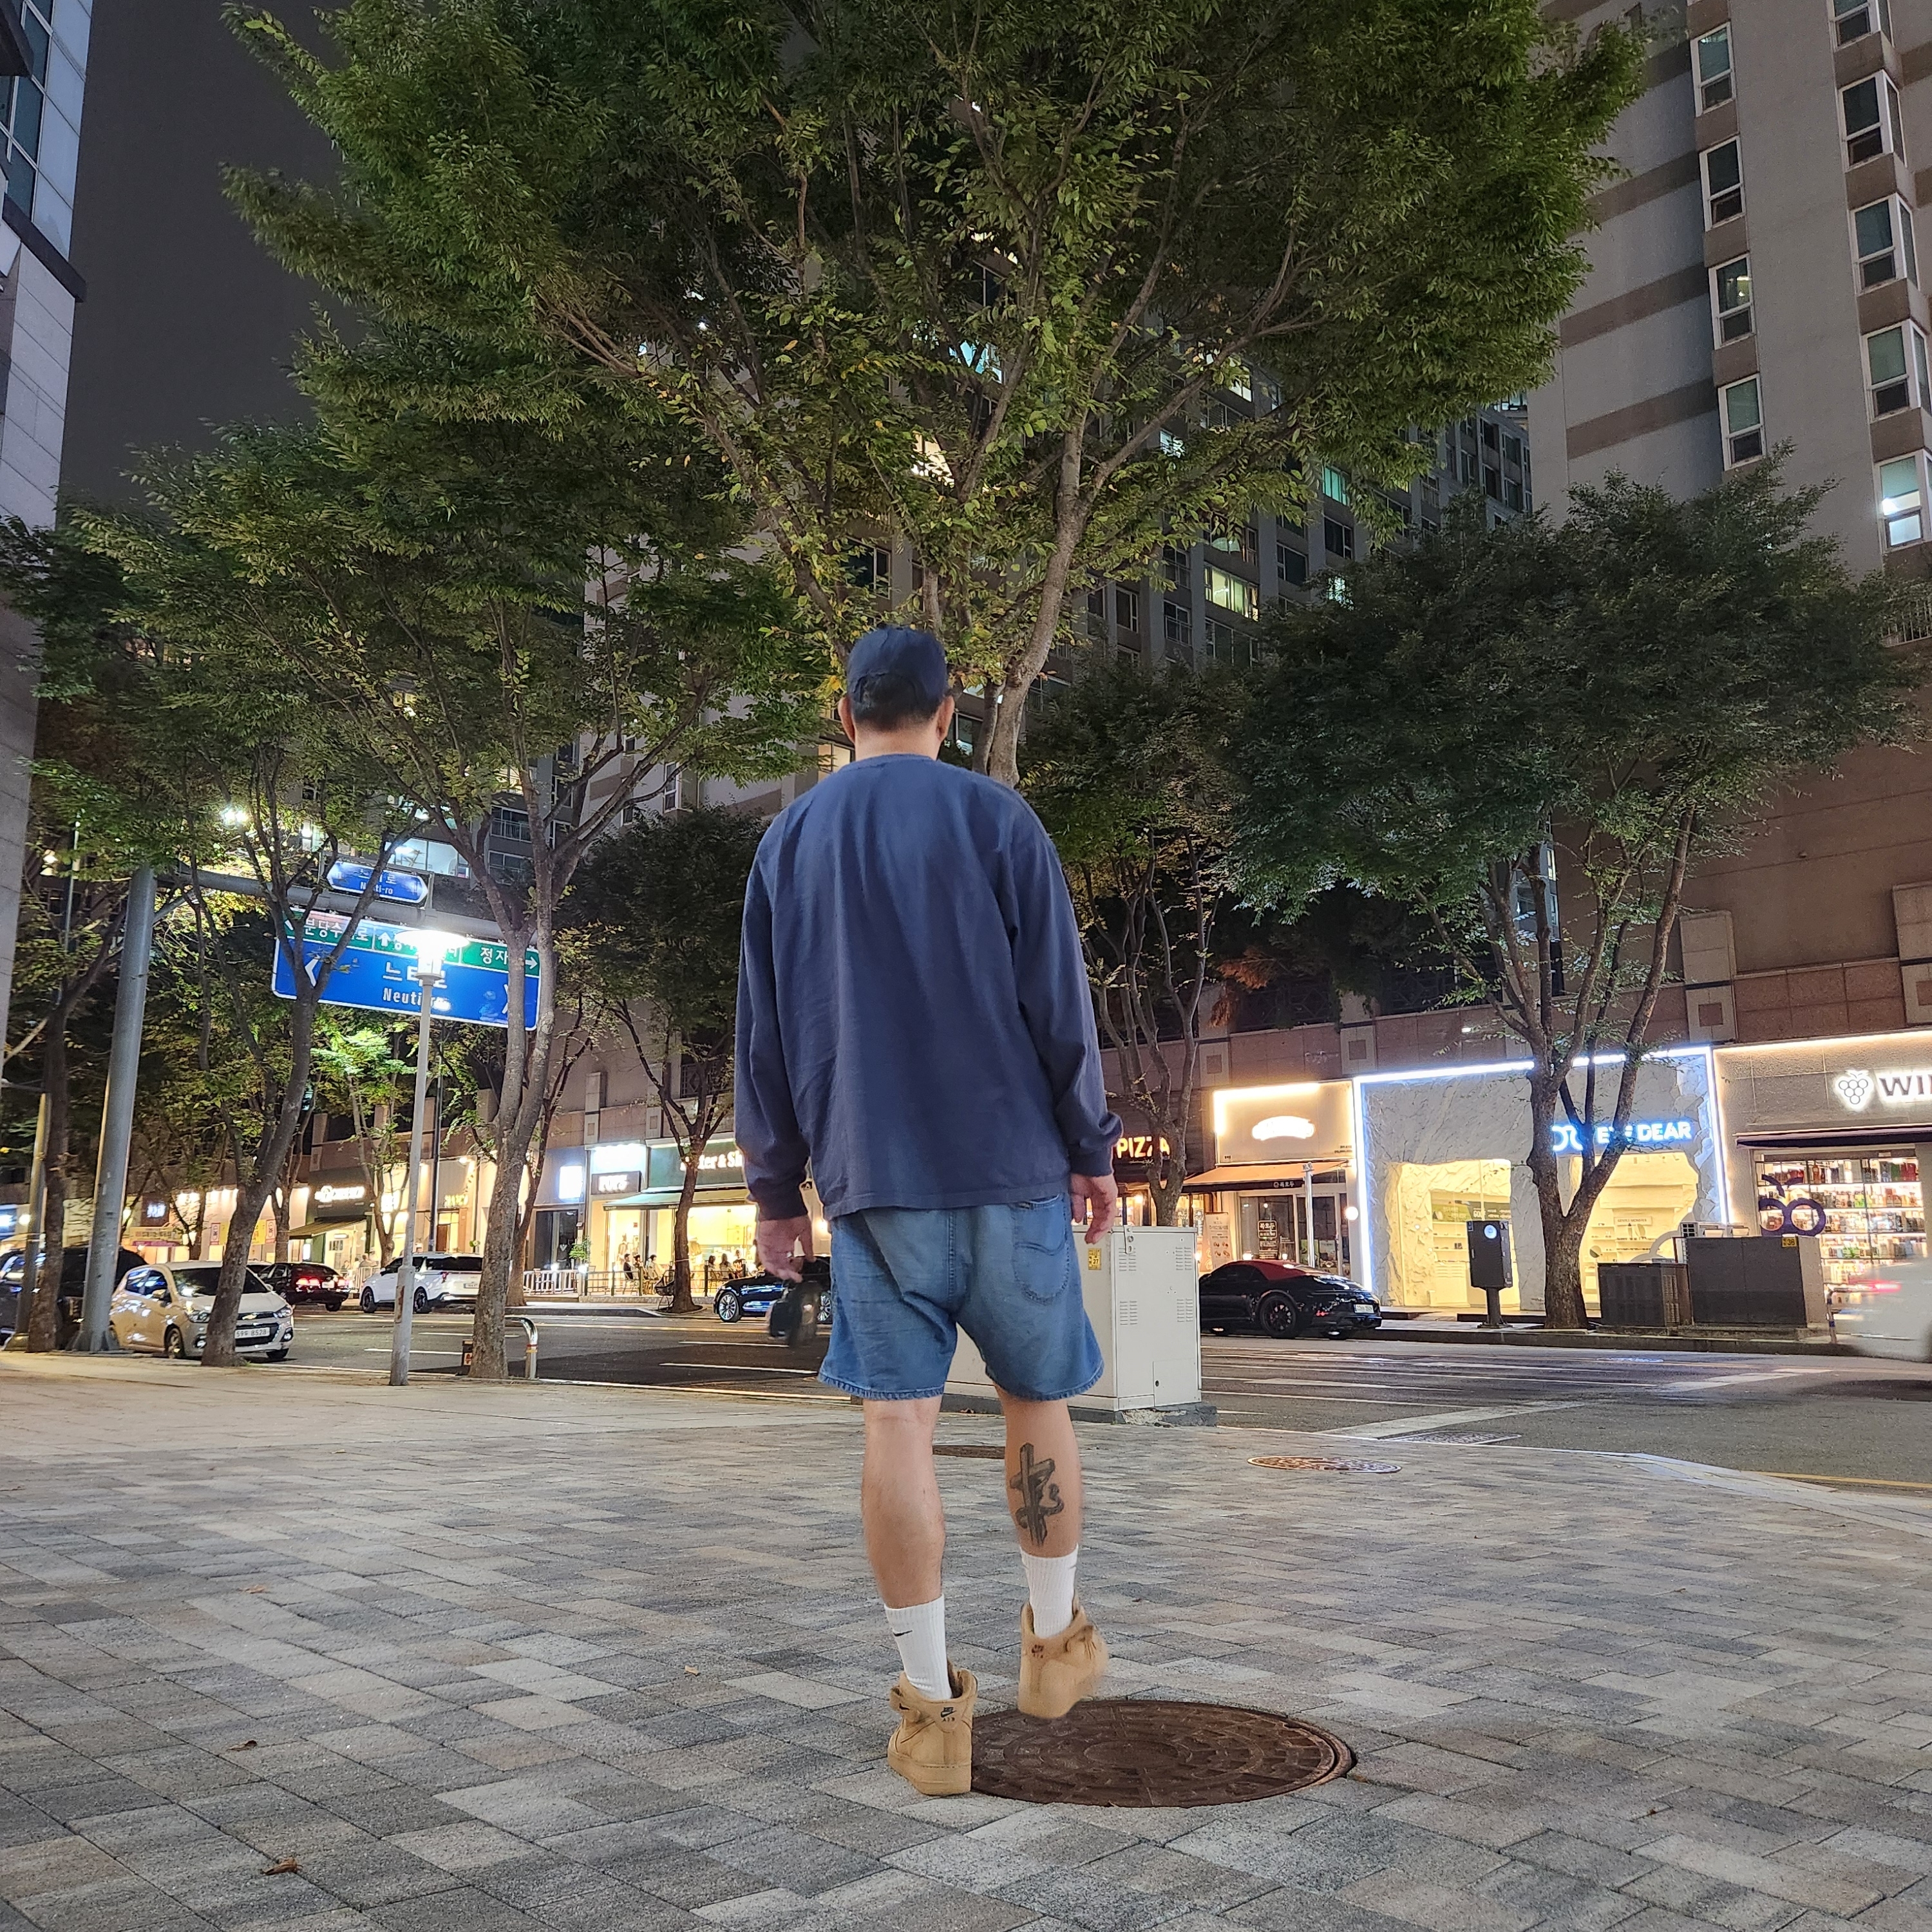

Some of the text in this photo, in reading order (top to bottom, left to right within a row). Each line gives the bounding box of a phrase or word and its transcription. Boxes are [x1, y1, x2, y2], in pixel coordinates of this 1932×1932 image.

[360, 882, 393, 895] Nti-ro
[305, 918, 369, 942] 분당수로
[383, 987, 444, 1009] Neutir
[1879, 1074, 1932, 1097] WI
[1638, 1121, 1692, 1141] DEAR
